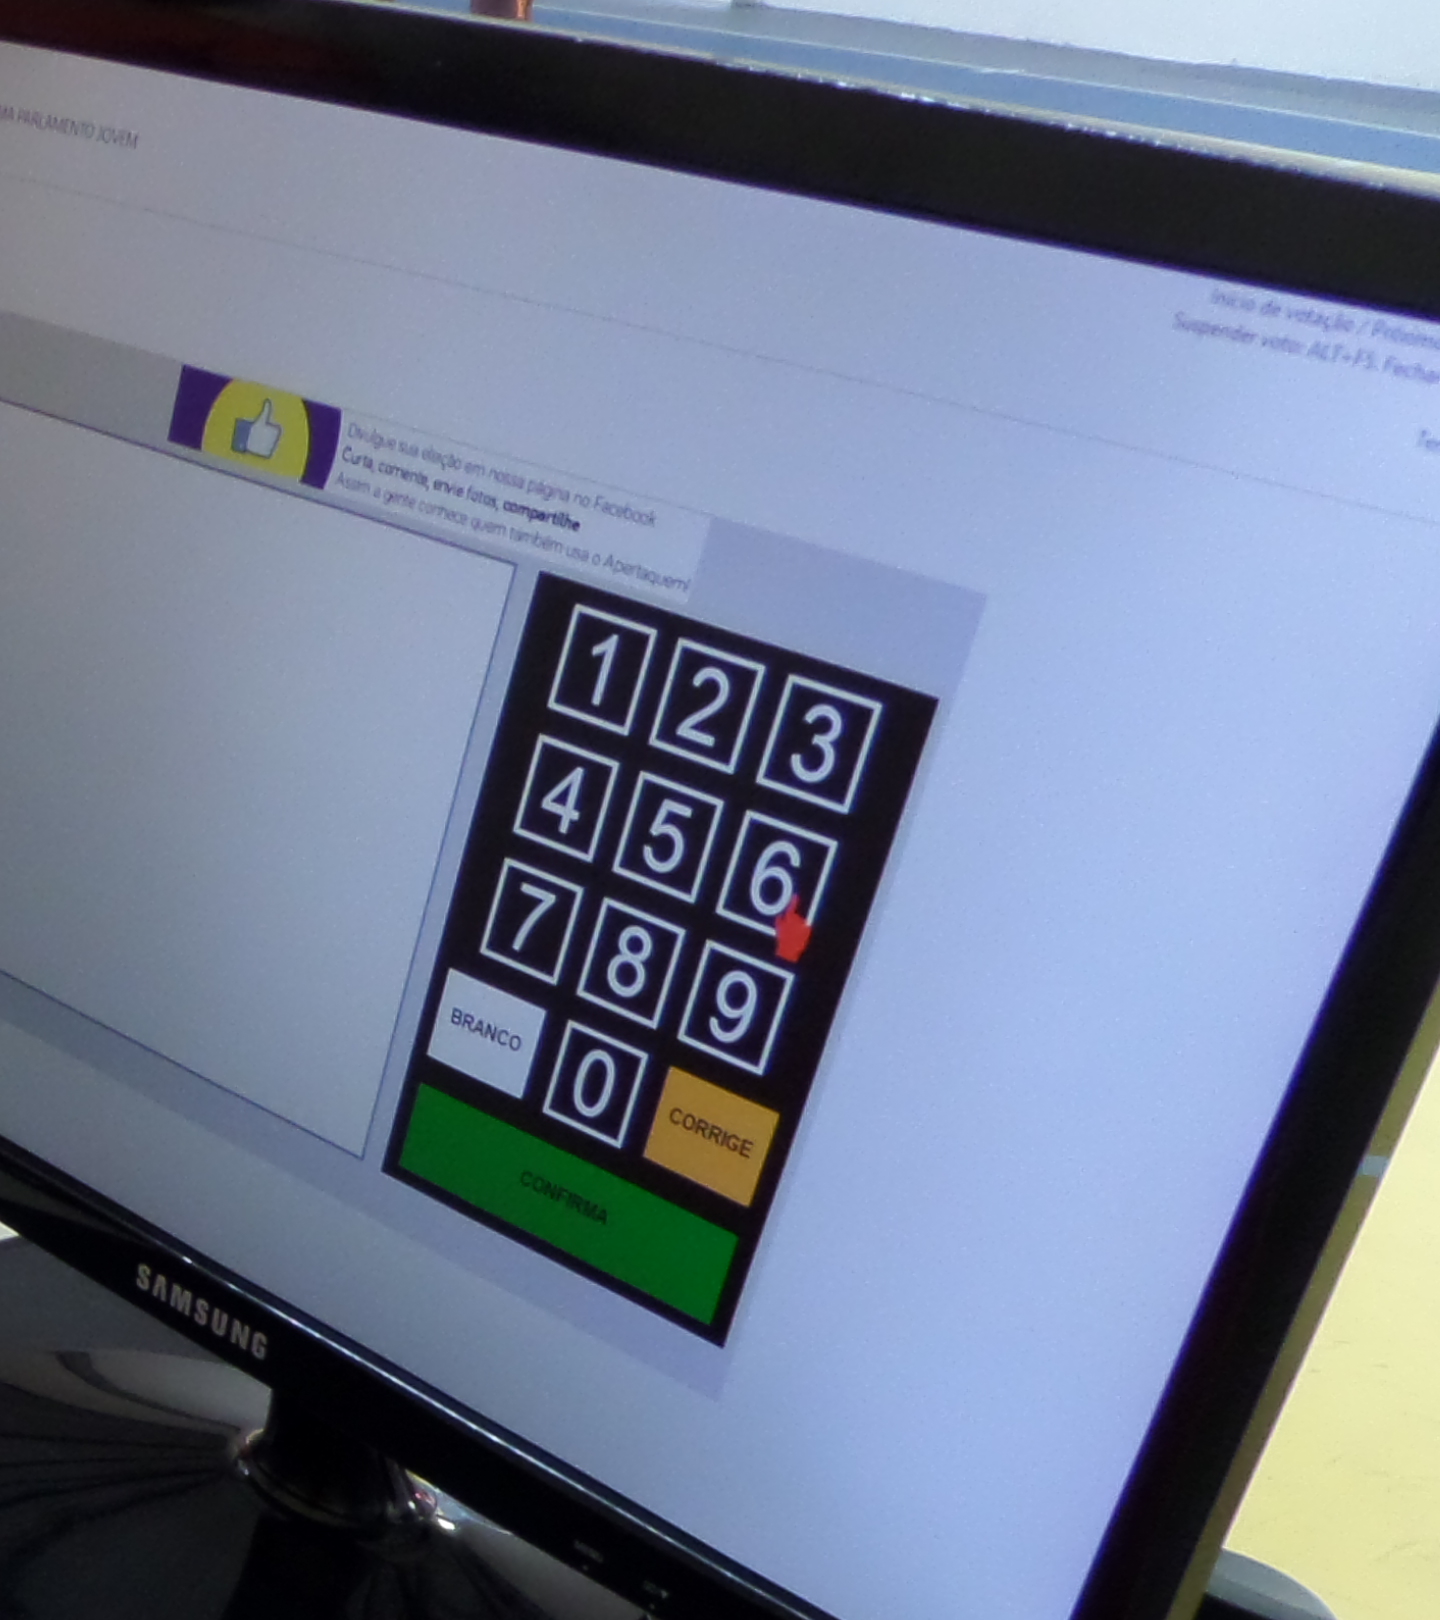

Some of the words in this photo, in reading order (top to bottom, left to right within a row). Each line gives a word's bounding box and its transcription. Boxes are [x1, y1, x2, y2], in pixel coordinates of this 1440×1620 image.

[17, 107, 96, 140] PARLAMENTO
[94, 124, 140, 150] JOVEM
[347, 421, 397, 450] Divulgue
[397, 441, 419, 458] sua
[464, 460, 487, 477] em
[488, 467, 526, 490] nossa
[572, 492, 591, 508] no
[593, 494, 657, 528] Facebook
[433, 477, 465, 499] envie
[502, 499, 581, 533] compartilhe
[383, 488, 417, 511] gente
[418, 501, 469, 526] conhece
[470, 516, 507, 537] quem
[508, 525, 564, 556] também
[565, 545, 590, 563] usa
[591, 552, 602, 567] o
[591, 633, 620, 706] 1
[675, 666, 730, 748] 2
[790, 703, 843, 784] 3
[540, 766, 585, 835] 4
[642, 798, 693, 874] 5
[750, 840, 802, 917] 6
[512, 881, 556, 952] 7
[607, 925, 653, 999] 8
[450, 1007, 524, 1053] BRANCO
[708, 970, 758, 1044] 9
[573, 1048, 617, 1119] 0
[668, 1106, 755, 1161] CORRIGE
[519, 1168, 611, 1226] CONFIRMA
[135, 1262, 269, 1362] SAMSUNG
